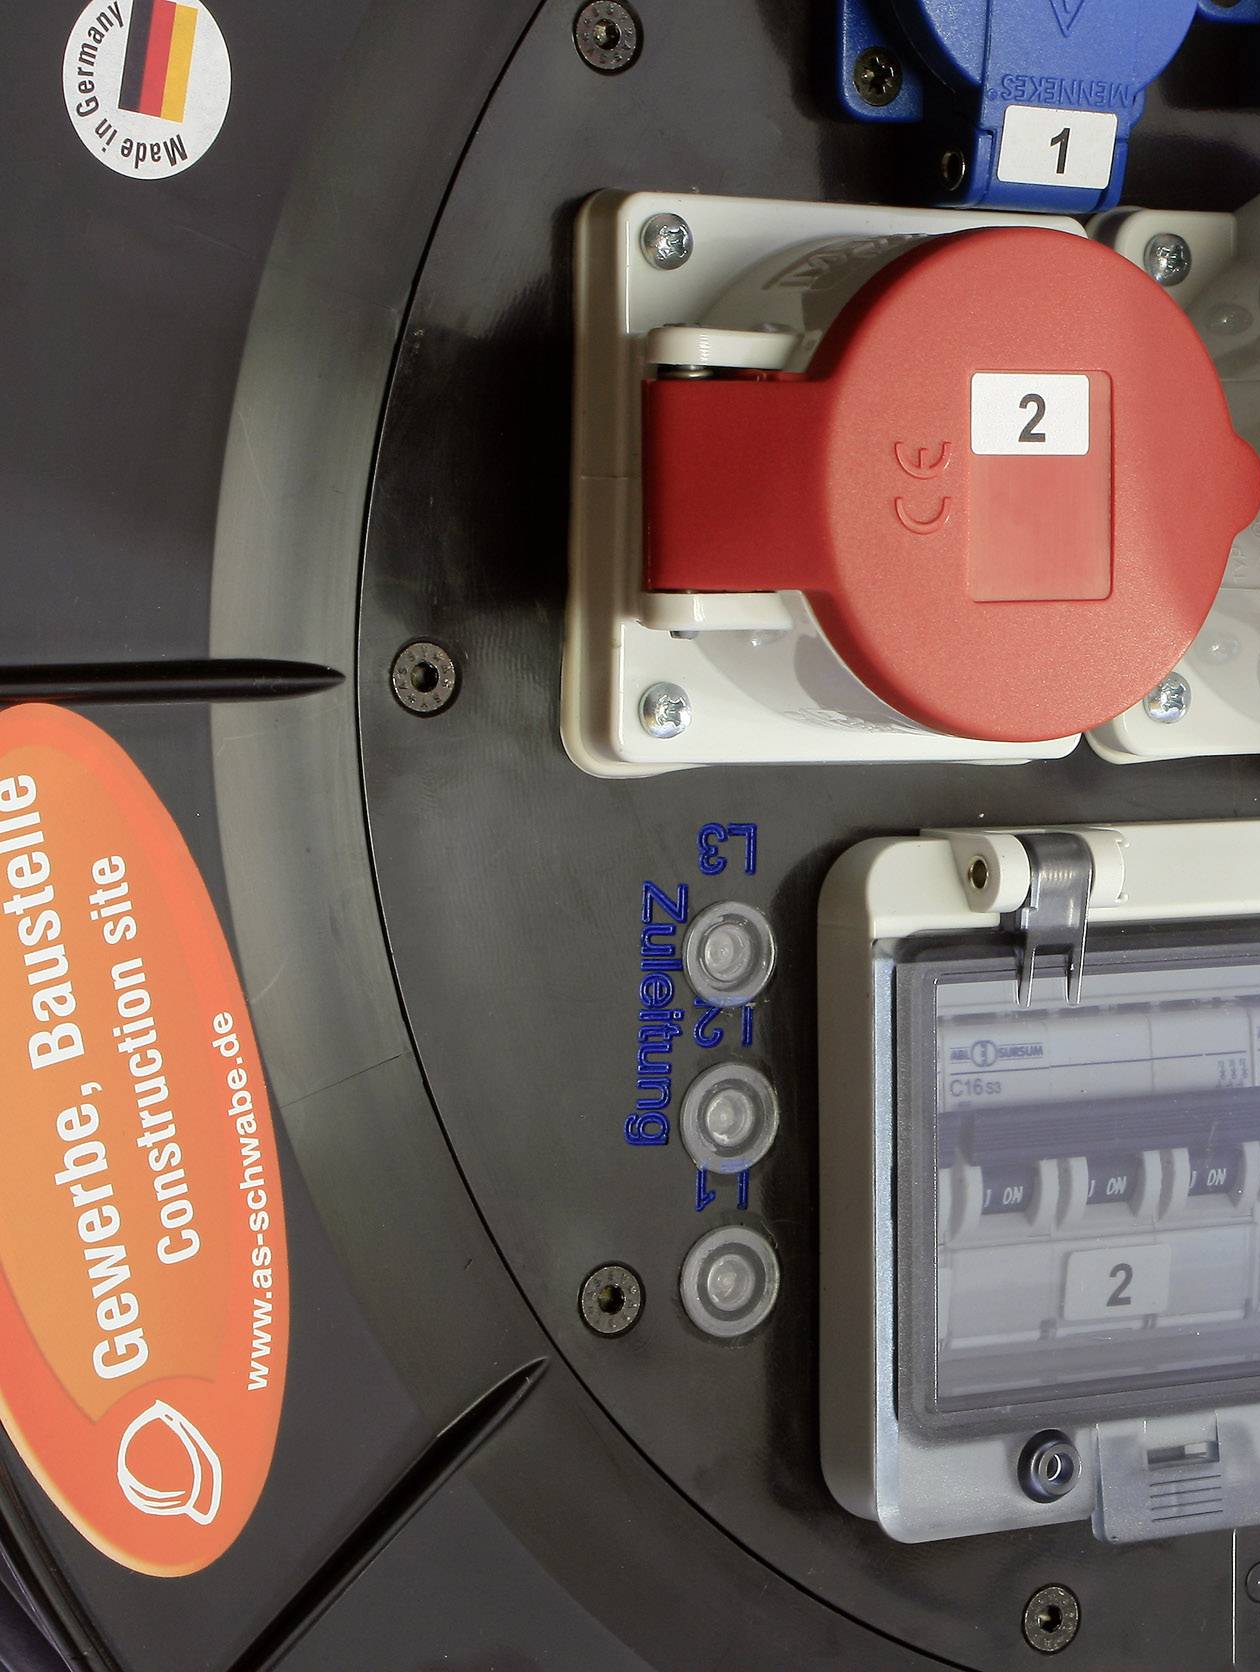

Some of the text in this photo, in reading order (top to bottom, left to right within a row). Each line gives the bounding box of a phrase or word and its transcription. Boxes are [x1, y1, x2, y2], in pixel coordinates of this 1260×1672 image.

[75, 0, 189, 169] Made in Germany
[1000, 73, 1130, 108] MENNEKES
[1049, 126, 1071, 175] 1
[1017, 393, 1047, 443] 2
[698, 822, 759, 876] L3
[624, 880, 689, 1147] Zuleitung
[693, 996, 755, 1049] L2
[0, 774, 150, 1380] Gewerbe, Baustelle
[88, 854, 201, 1265] Construction site
[212, 1011, 273, 1391] www.as-schwabe.de
[1002, 1186, 1024, 1205] ON
[1106, 1176, 1127, 1195] ON
[1207, 1168, 1227, 1186] ON
[1105, 1262, 1135, 1307] 2
